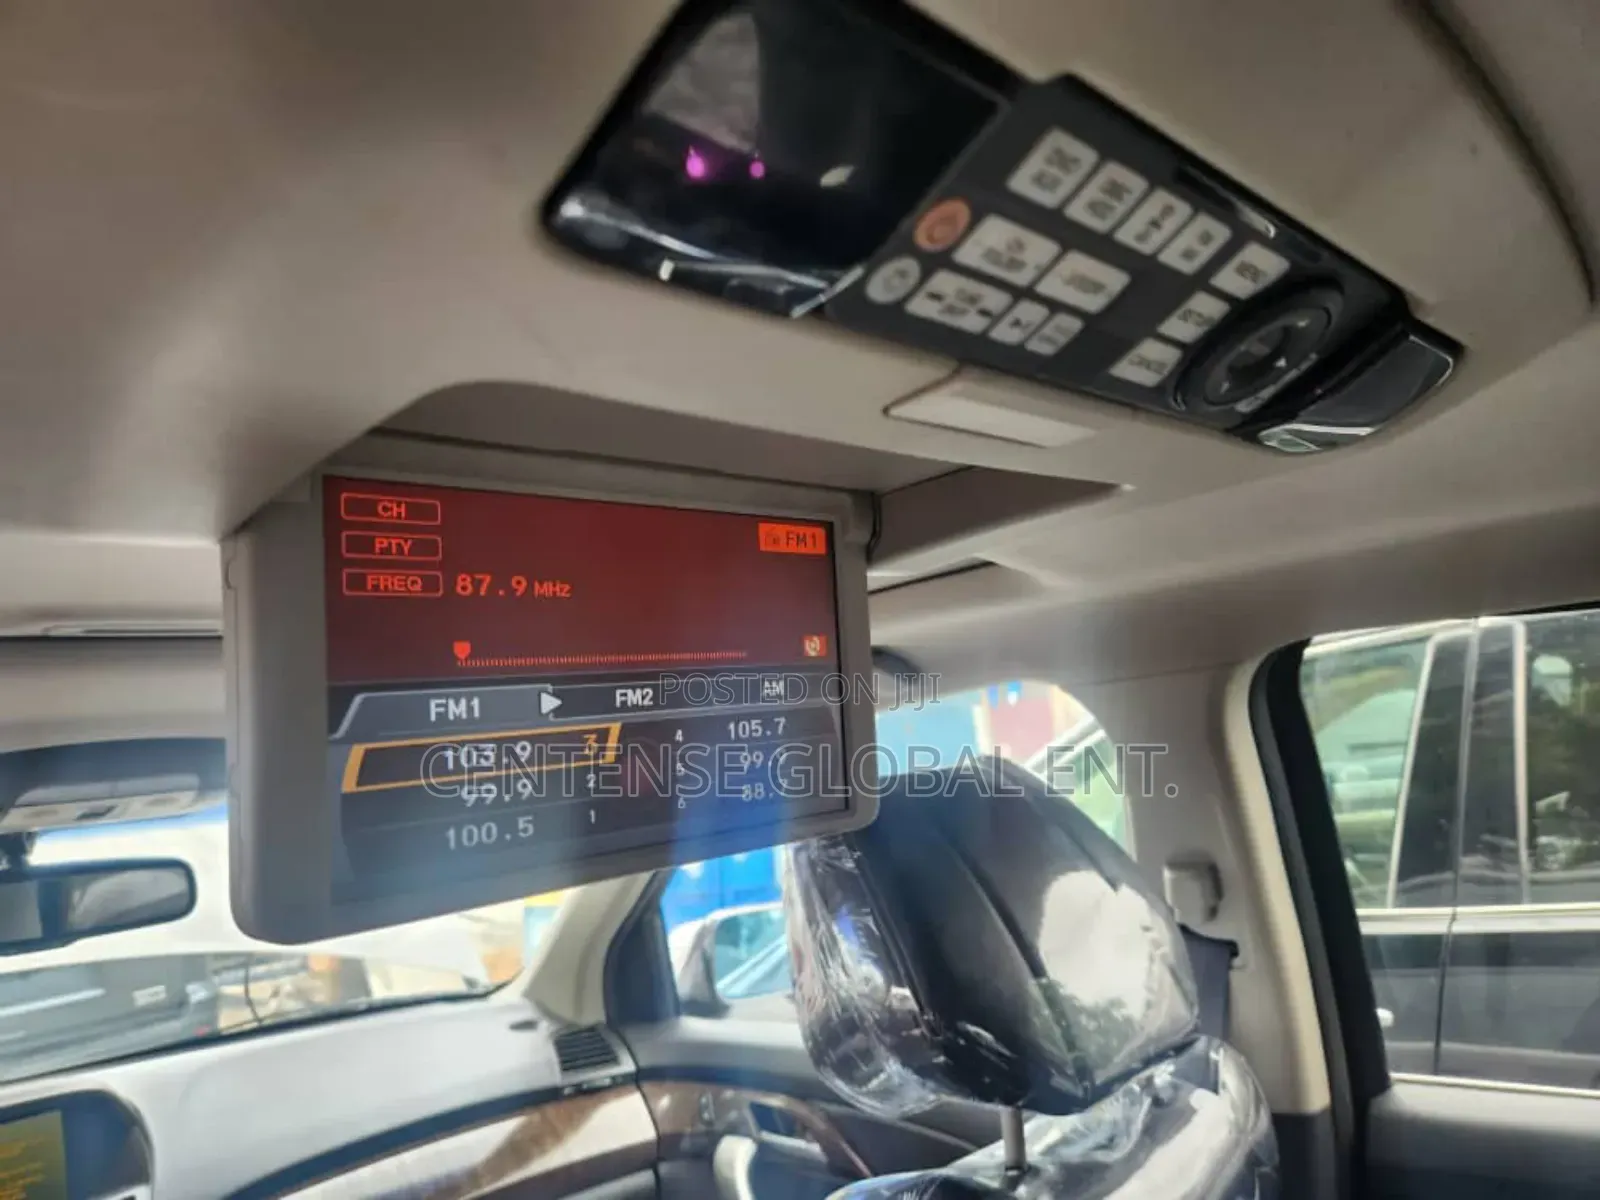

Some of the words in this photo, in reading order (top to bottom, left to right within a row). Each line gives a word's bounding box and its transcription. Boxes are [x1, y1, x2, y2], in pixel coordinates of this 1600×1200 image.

[377, 502, 406, 519] CH
[374, 537, 412, 556] PTY
[786, 530, 818, 549] FM1
[366, 575, 423, 592] FREQ
[456, 573, 527, 597] 87.9
[533, 580, 572, 598] MHz
[615, 688, 653, 708] FM2
[763, 680, 784, 698] AM
[429, 696, 480, 722] FM1
[675, 729, 683, 743] 4
[727, 717, 787, 741] 105.7
[583, 733, 597, 756] 3
[444, 740, 532, 771] 103.9
[675, 762, 685, 777] 5
[586, 774, 597, 790] 2
[460, 778, 533, 808] 99.9
[589, 810, 596, 824] 1
[446, 815, 534, 850] 100.5
